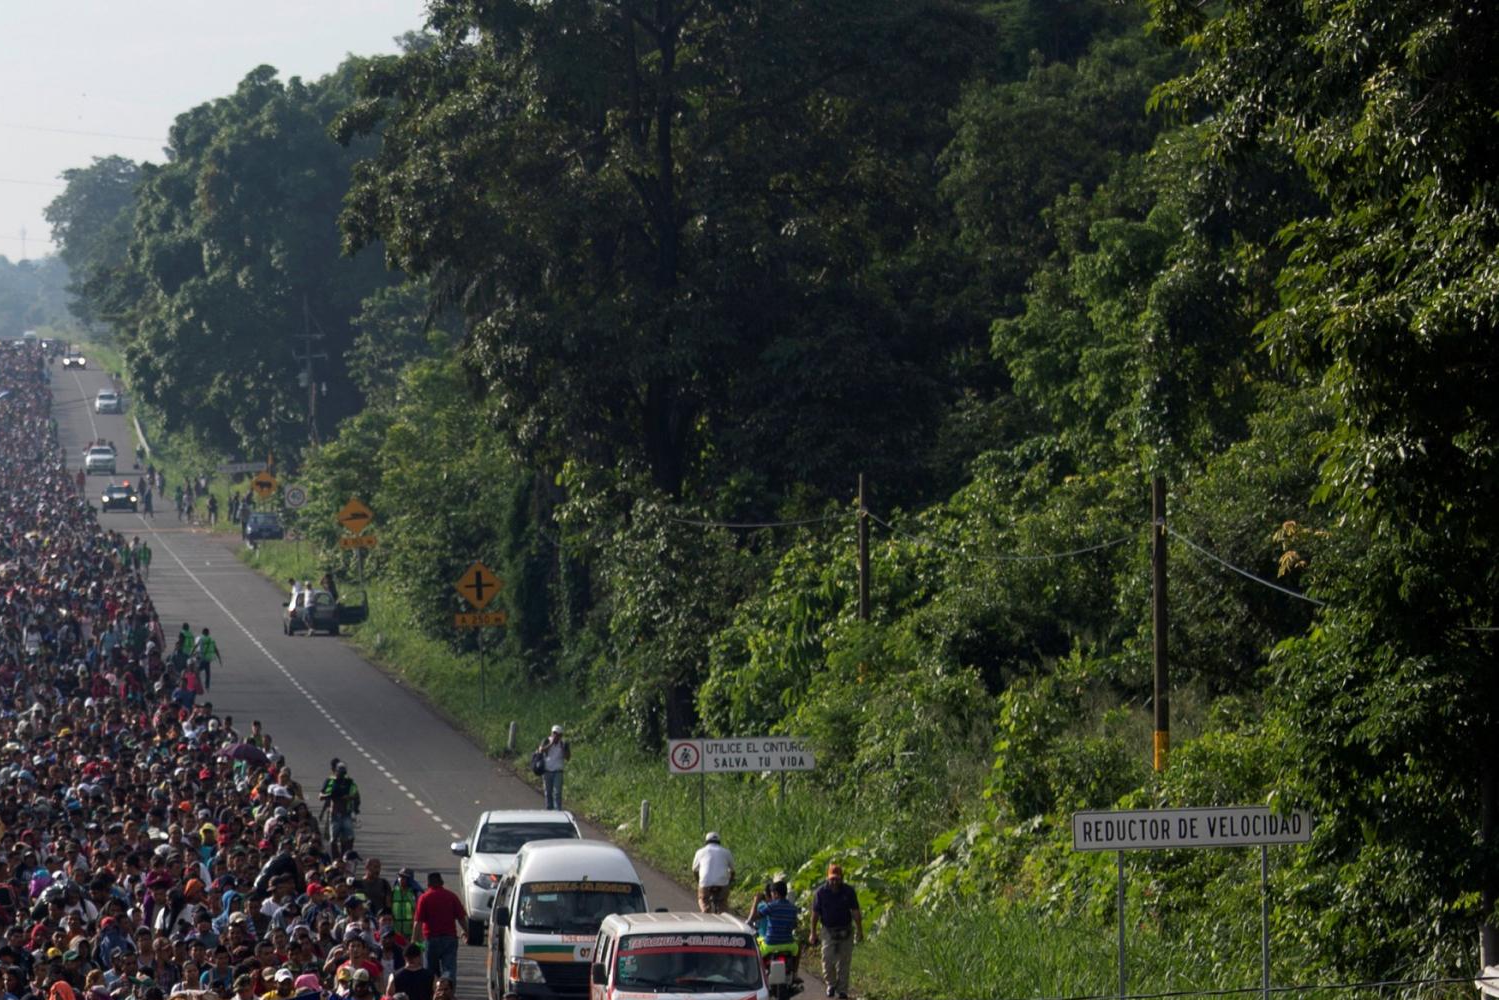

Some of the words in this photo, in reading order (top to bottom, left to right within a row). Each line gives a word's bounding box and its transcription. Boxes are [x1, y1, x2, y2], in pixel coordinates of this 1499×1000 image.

[706, 743, 742, 754] UTILICE
[746, 742, 758, 753] EL
[764, 741, 813, 753] CINTURO
[713, 757, 748, 768] SALVA
[759, 757, 771, 767] TU
[780, 756, 805, 767] VIDA
[1083, 819, 1170, 842] REDUCTOR
[1178, 818, 1198, 839] DE
[1207, 813, 1302, 838] VELOCIDAD
